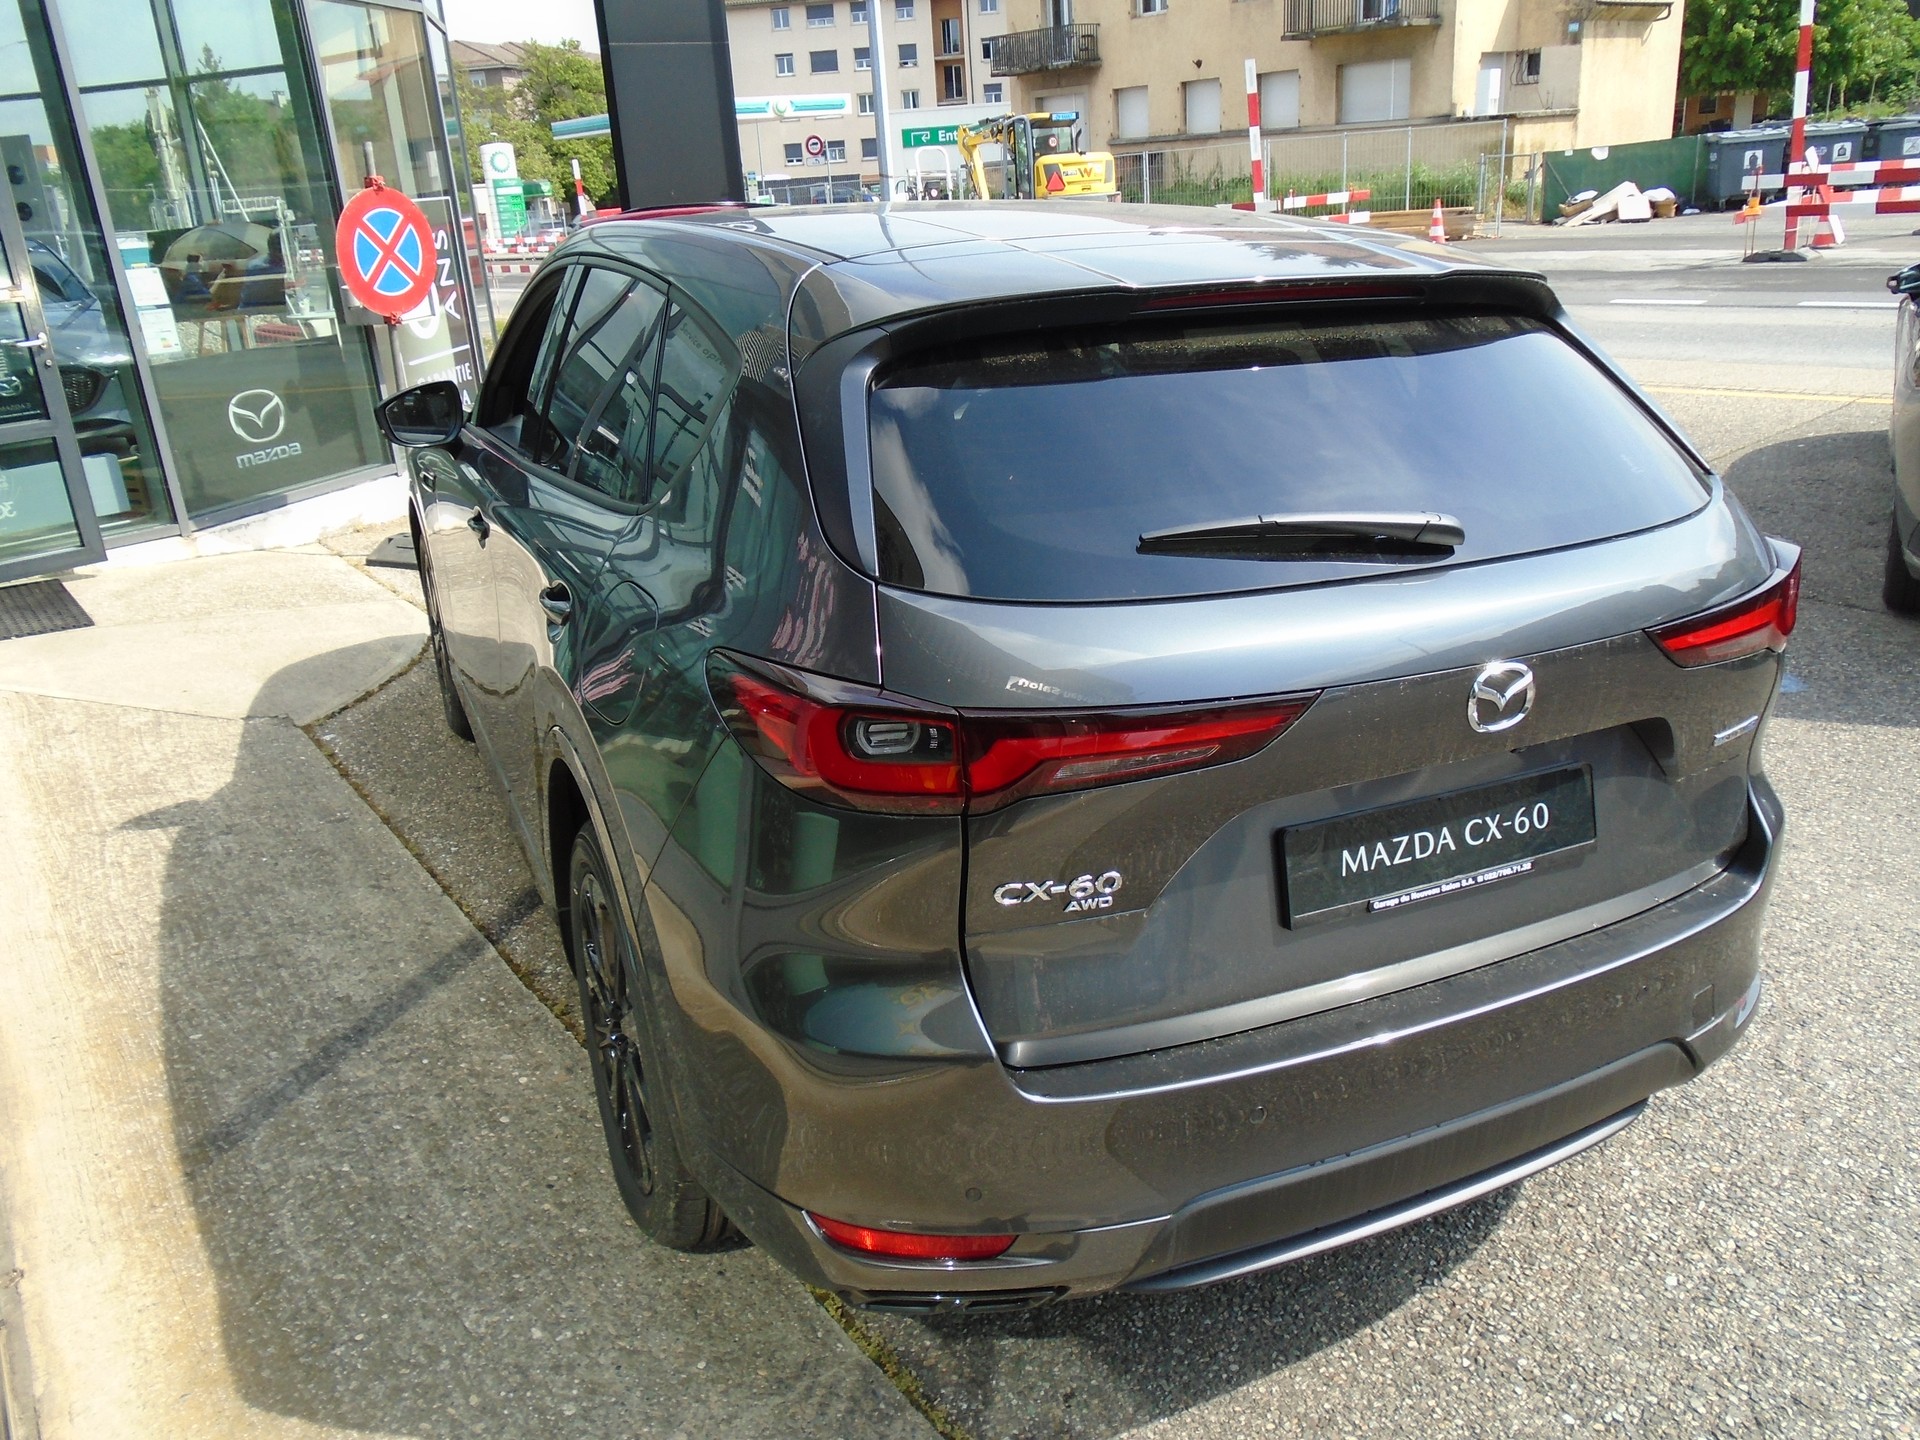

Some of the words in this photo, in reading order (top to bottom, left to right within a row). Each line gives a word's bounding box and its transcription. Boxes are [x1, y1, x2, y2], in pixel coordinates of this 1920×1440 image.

[1341, 826, 1456, 877] MAZDA
[1464, 802, 1549, 846] CX-60
[993, 870, 1123, 905] CX-60
[1063, 895, 1113, 913] AWD
[1373, 898, 1400, 910] Garage
[1400, 893, 1410, 903] du
[1411, 886, 1441, 900] Nouveau
[1441, 881, 1461, 893] Salon
[1461, 878, 1476, 888] S.A.
